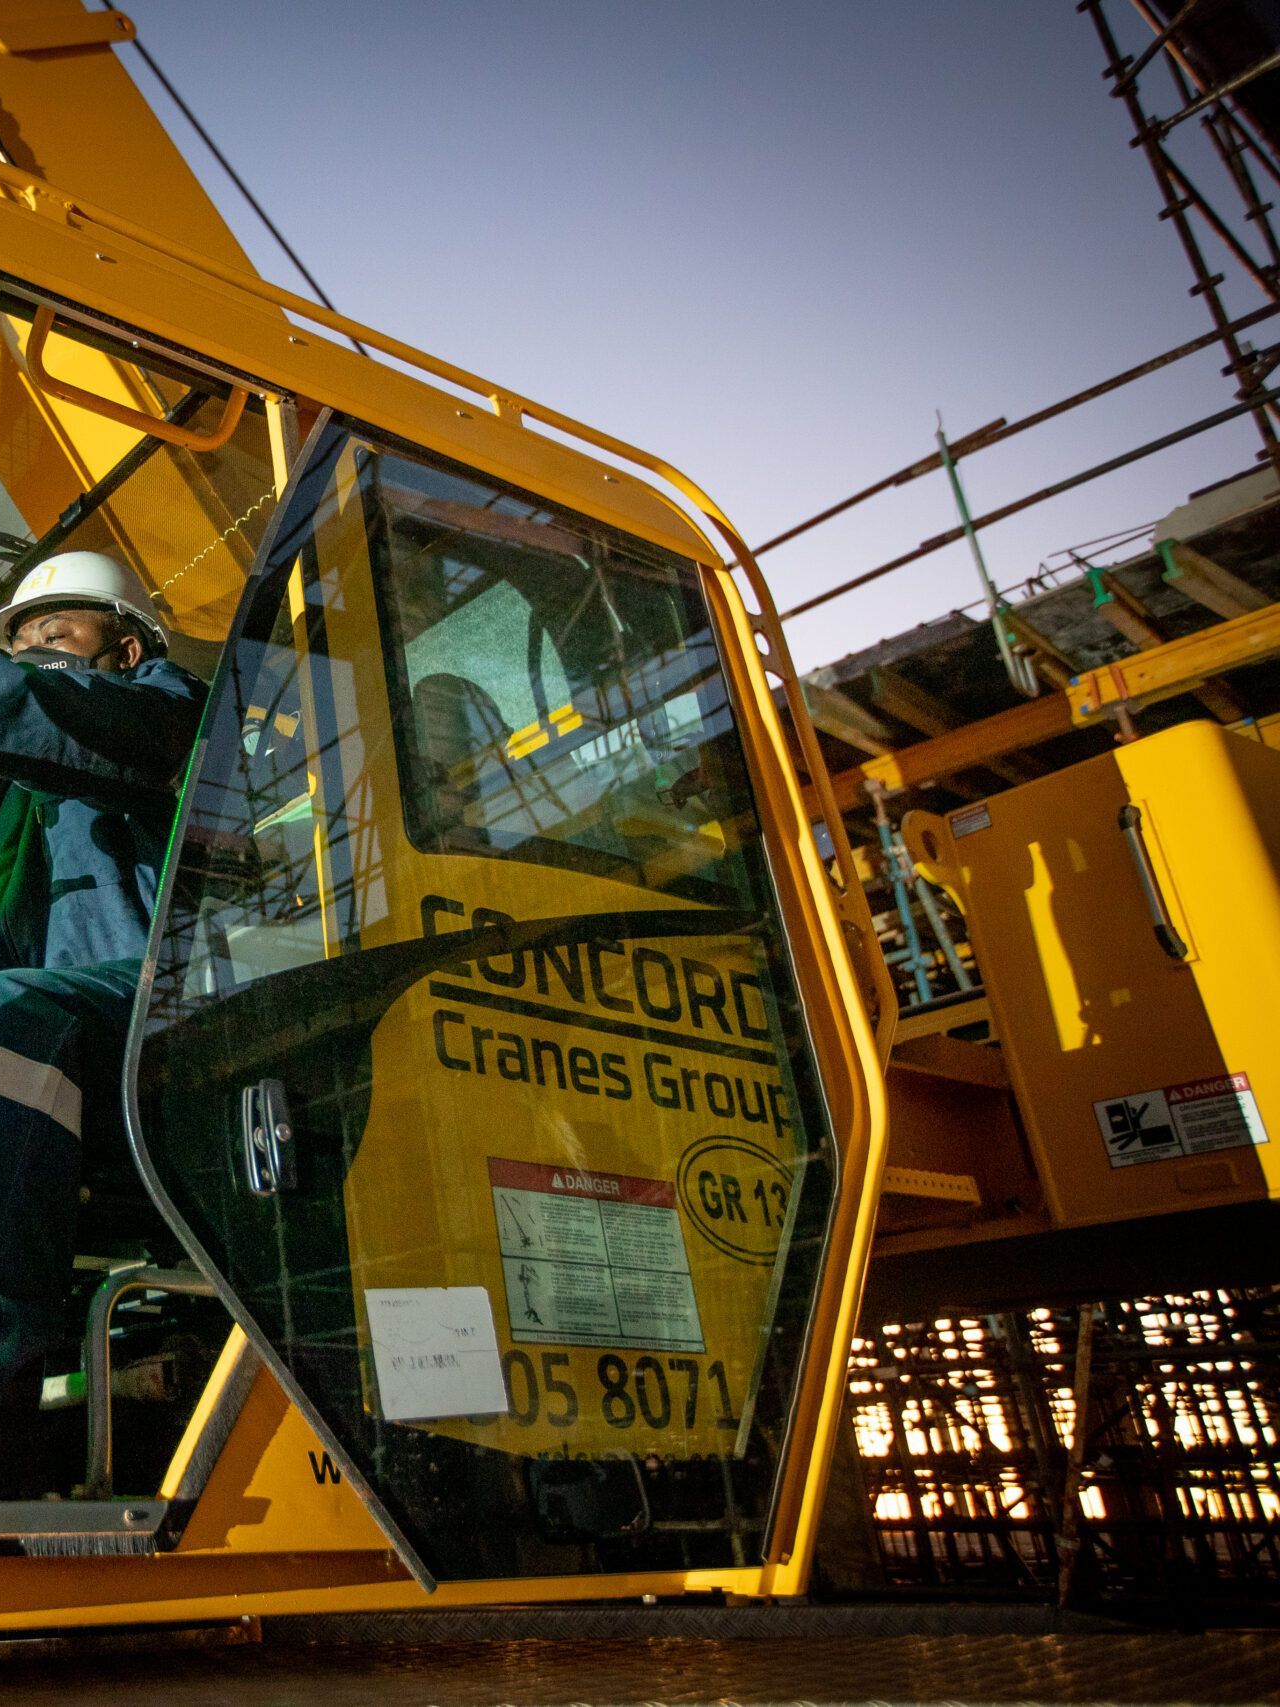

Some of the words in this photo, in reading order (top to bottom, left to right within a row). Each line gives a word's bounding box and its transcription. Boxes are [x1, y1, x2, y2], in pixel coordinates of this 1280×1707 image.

[38, 661, 68, 670] ORD
[420, 894, 772, 1042] CONCORD
[432, 1009, 633, 1101] Cranes
[642, 1051, 796, 1138] Group
[1182, 1076, 1247, 1098] DANGER
[565, 1174, 620, 1195] DANGER
[698, 1170, 748, 1223] GR
[466, 1350, 579, 1427] 05
[597, 1354, 742, 1430] 8071
